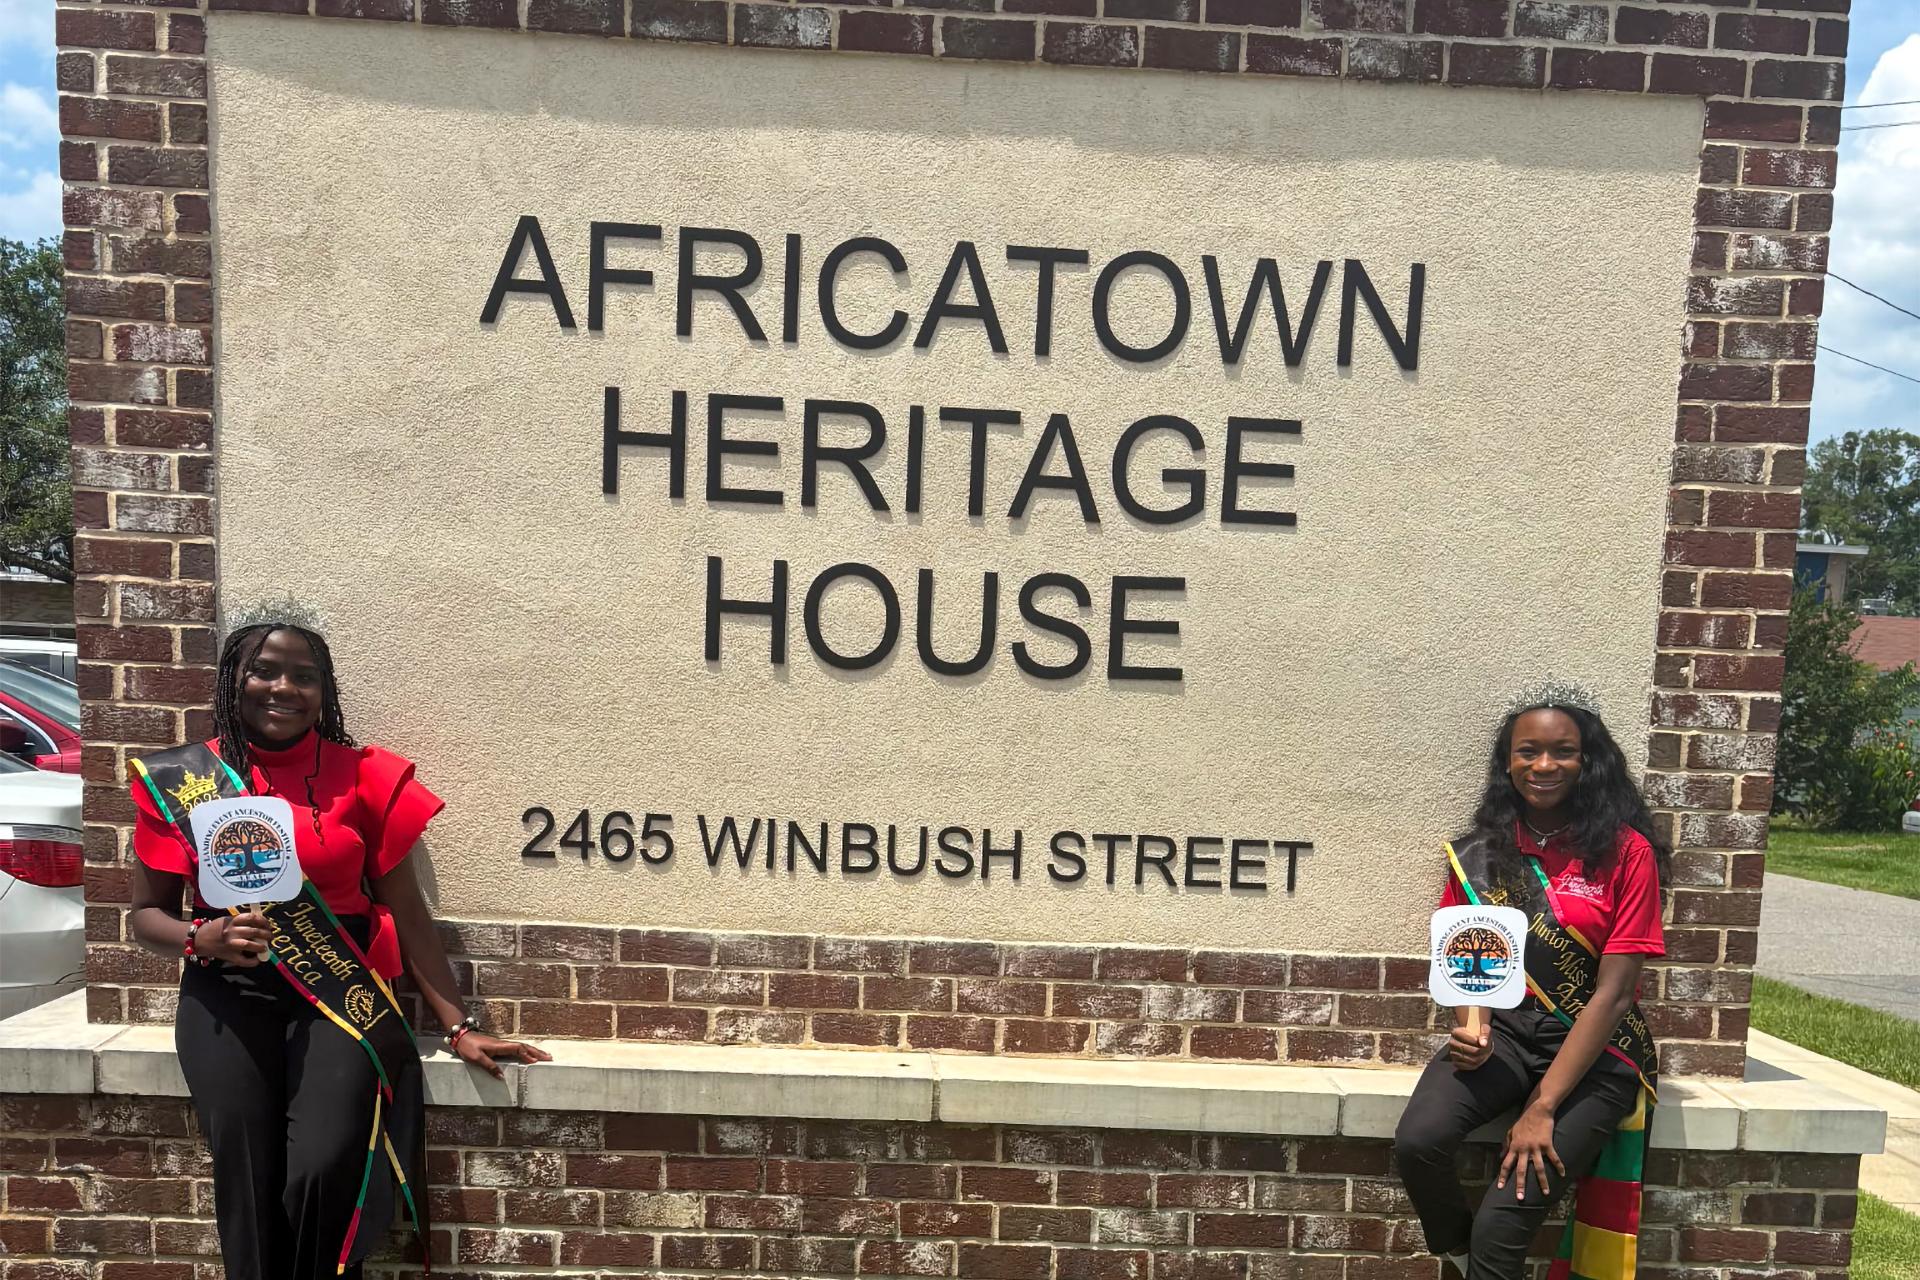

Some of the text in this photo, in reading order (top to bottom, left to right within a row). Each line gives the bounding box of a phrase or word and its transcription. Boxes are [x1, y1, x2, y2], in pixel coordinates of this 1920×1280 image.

[480, 215, 1426, 373] AFRICATOWN
[602, 386, 1303, 528] HERITAGE
[704, 555, 1186, 683] HOUSE
[212, 811, 233, 831] EVENT
[234, 808, 273, 824] ANCESTOR
[272, 821, 292, 853] FESTIVAL
[520, 805, 1314, 893] 2465 WINBUSH STREET
[284, 902, 360, 981] Juneteenth
[1528, 912, 1573, 951] Junior
[1552, 951, 1588, 986] Miss
